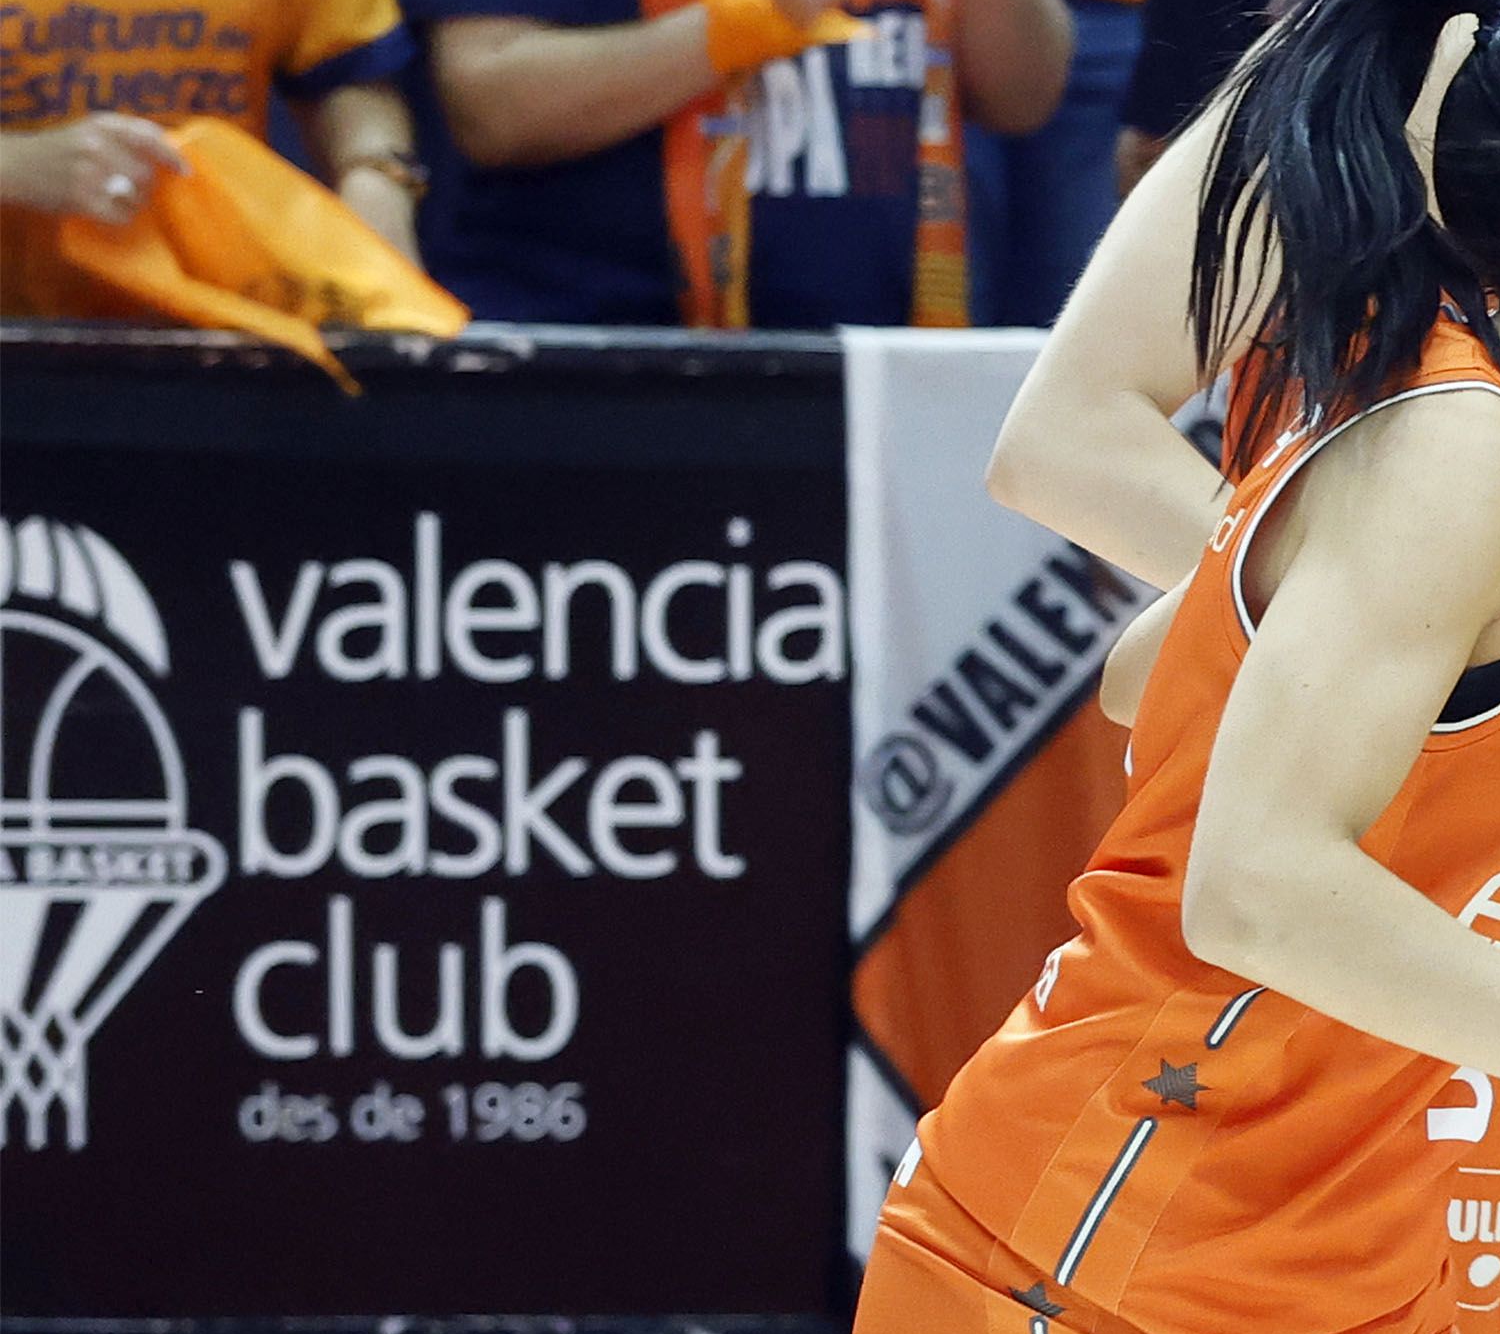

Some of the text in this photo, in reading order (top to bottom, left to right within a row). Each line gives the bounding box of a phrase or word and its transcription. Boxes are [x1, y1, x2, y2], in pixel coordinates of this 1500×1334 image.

[230, 510, 846, 684] valencia
[237, 707, 749, 880] basket
[231, 894, 581, 1063] club
[237, 1080, 589, 1144] des de 1986
